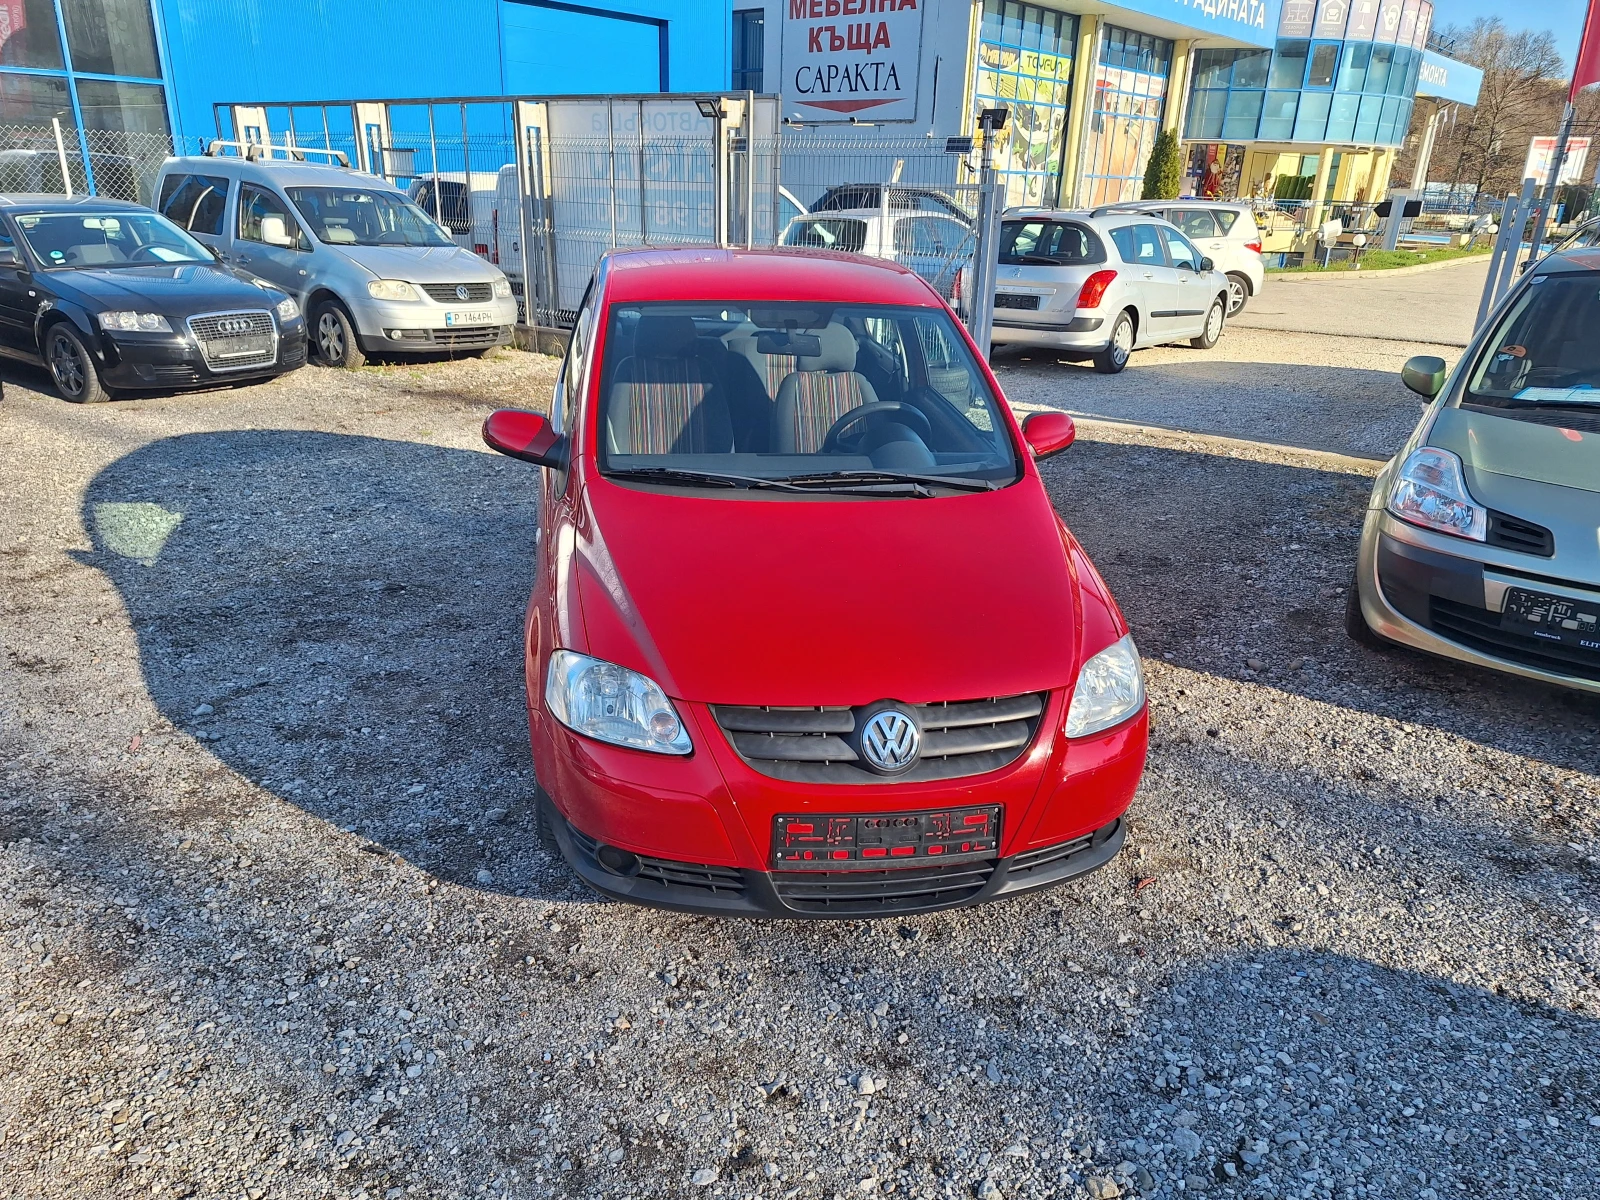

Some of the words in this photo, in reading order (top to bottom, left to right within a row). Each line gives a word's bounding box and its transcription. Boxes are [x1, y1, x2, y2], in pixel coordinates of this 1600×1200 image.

[1174, 0, 1265, 29] ДИНАТА
[808, 21, 891, 54] КЪЩА
[795, 61, 901, 94] САРАКТА
[1419, 61, 1448, 87] ЕМОНТА
